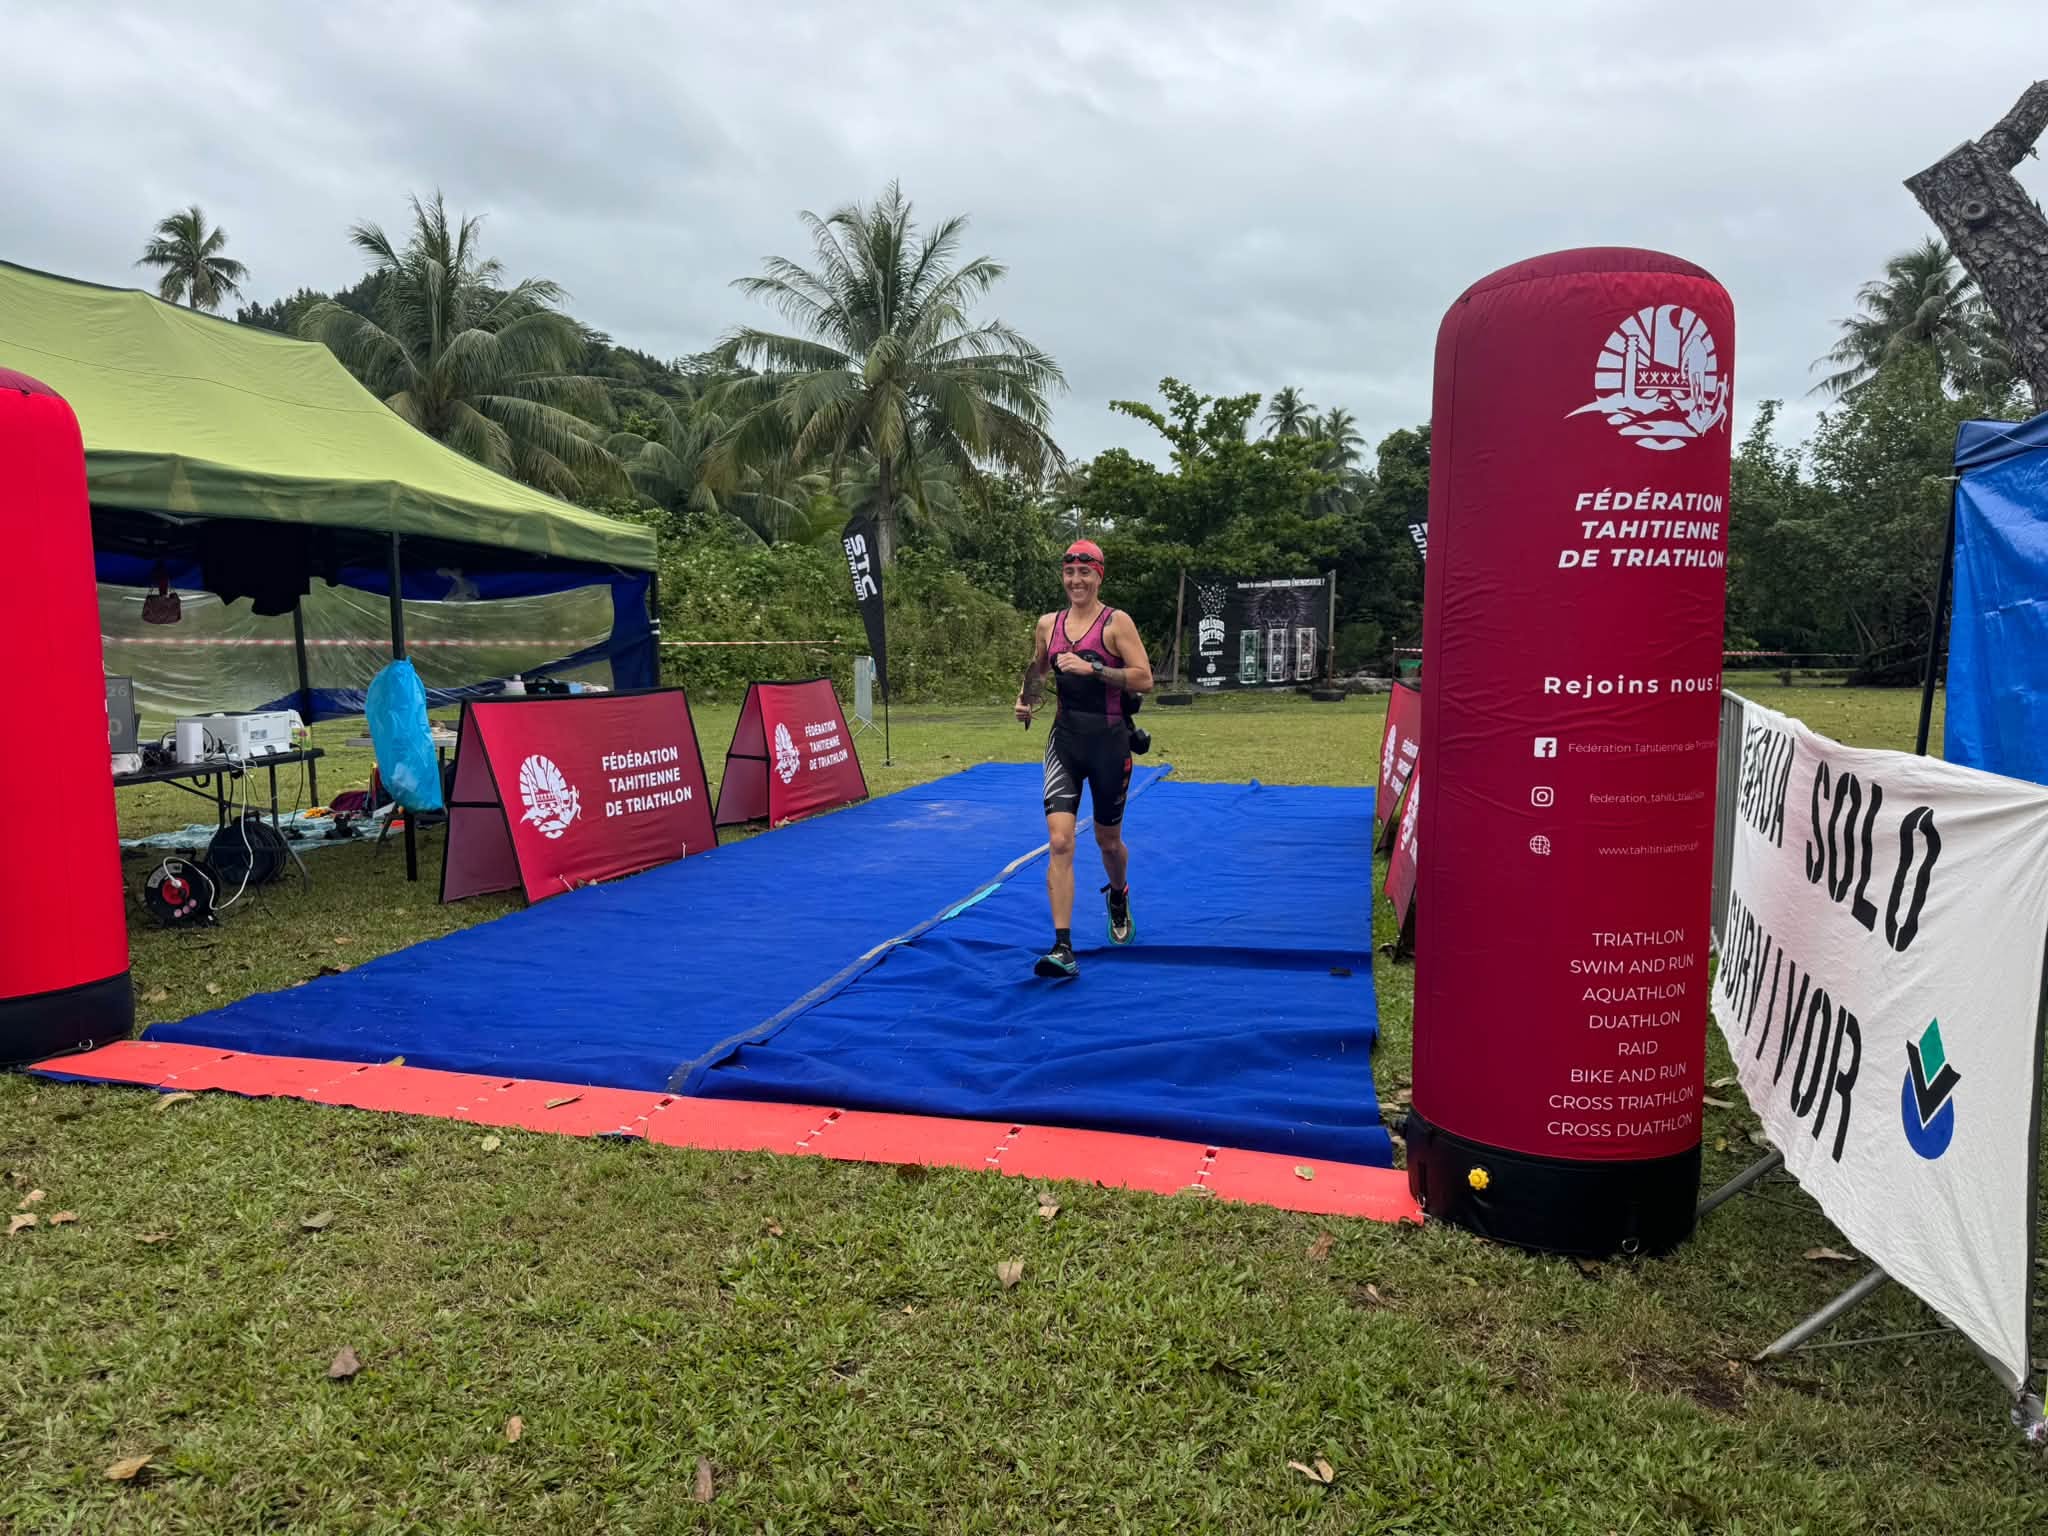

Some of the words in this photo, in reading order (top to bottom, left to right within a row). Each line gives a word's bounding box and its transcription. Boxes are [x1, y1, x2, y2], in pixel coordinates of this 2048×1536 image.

[1575, 487, 1722, 513] FÉDÉRATION
[1581, 520, 1720, 541] TAHITIENNE
[1558, 550, 1600, 569] DE
[1611, 549, 1724, 569] TRIATHLON
[1544, 675, 1659, 699] Rejoins
[602, 746, 679, 772] FÉDÉRATION
[609, 767, 681, 793] TAHITIENNE
[605, 800, 623, 817] DE
[626, 786, 692, 814] TRIATHLON
[1805, 760, 1942, 953] SOLO
[1592, 928, 1685, 947] TRIATHLON
[1569, 959, 1624, 974] SWIM
[1628, 958, 1665, 973] AND
[1668, 953, 1694, 971] RUN
[1582, 982, 1686, 1004] AQUATHLON
[1589, 1009, 1681, 1029] DUATHLON
[1720, 889, 1862, 1163] SURVIVOR
[1618, 1040, 1658, 1056] RAID
[1570, 1068, 1614, 1083] BIKE
[1618, 1067, 1656, 1083] AND
[1659, 1062, 1687, 1079] RUN
[1549, 1094, 1613, 1110] CROSS
[1618, 1085, 1694, 1110] TRIATHLON
[1547, 1121, 1612, 1137] CROSS
[1617, 1112, 1692, 1137] DUATHLON
